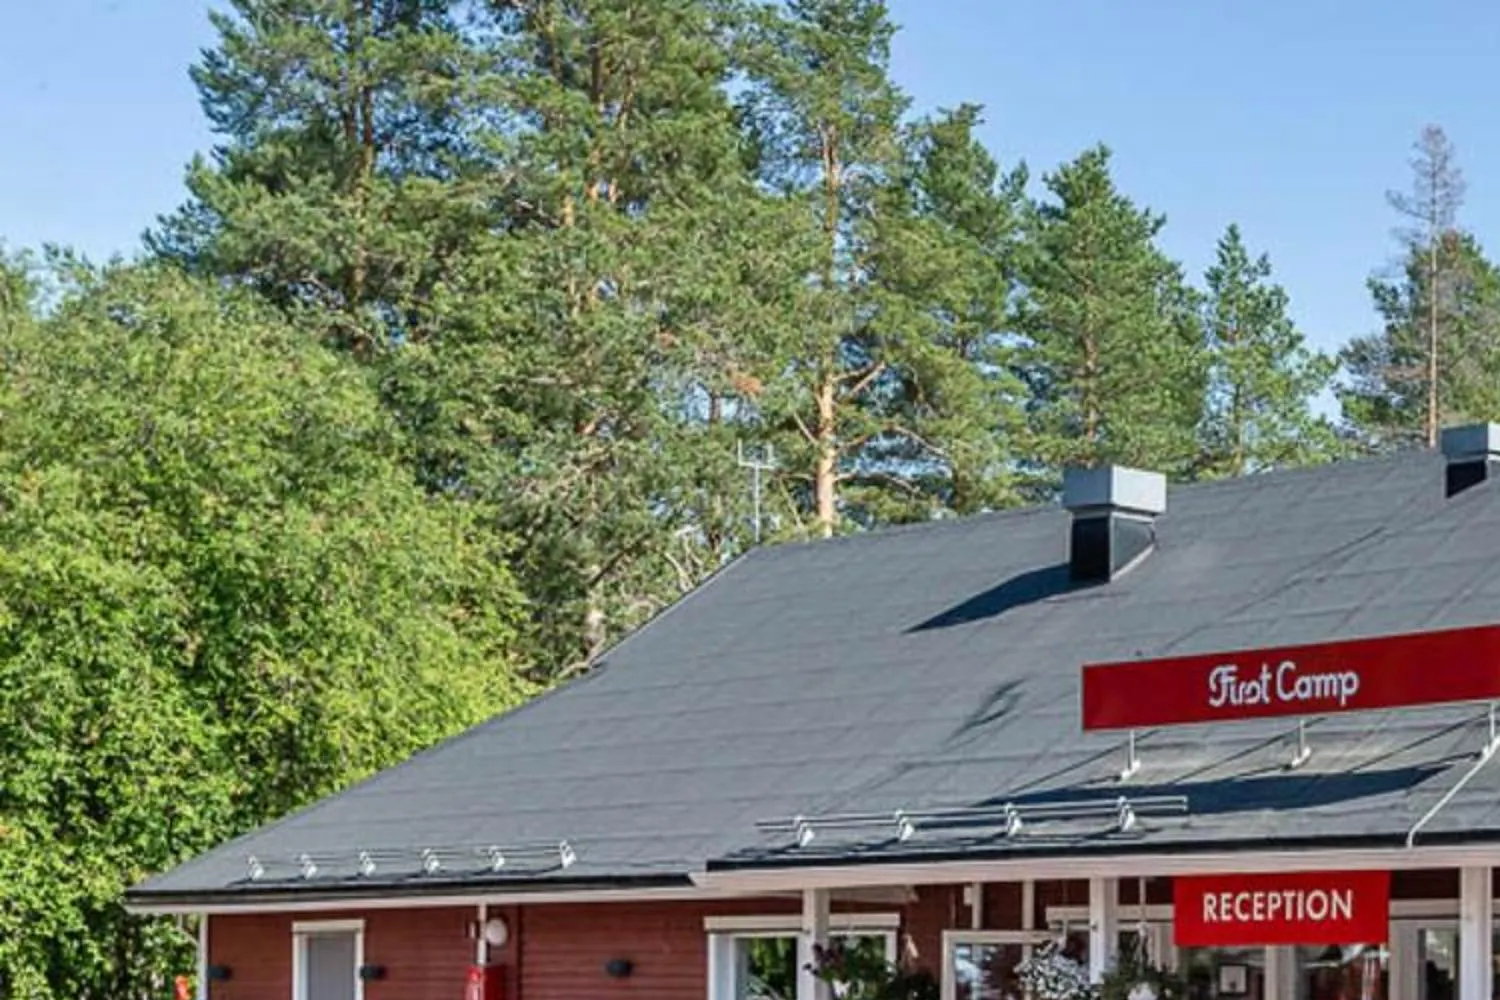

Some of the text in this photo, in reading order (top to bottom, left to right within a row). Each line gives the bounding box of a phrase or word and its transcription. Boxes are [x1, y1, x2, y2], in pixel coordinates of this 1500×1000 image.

[1209, 660, 1359, 707] First Camp
[1203, 889, 1353, 923] RECEPTION
